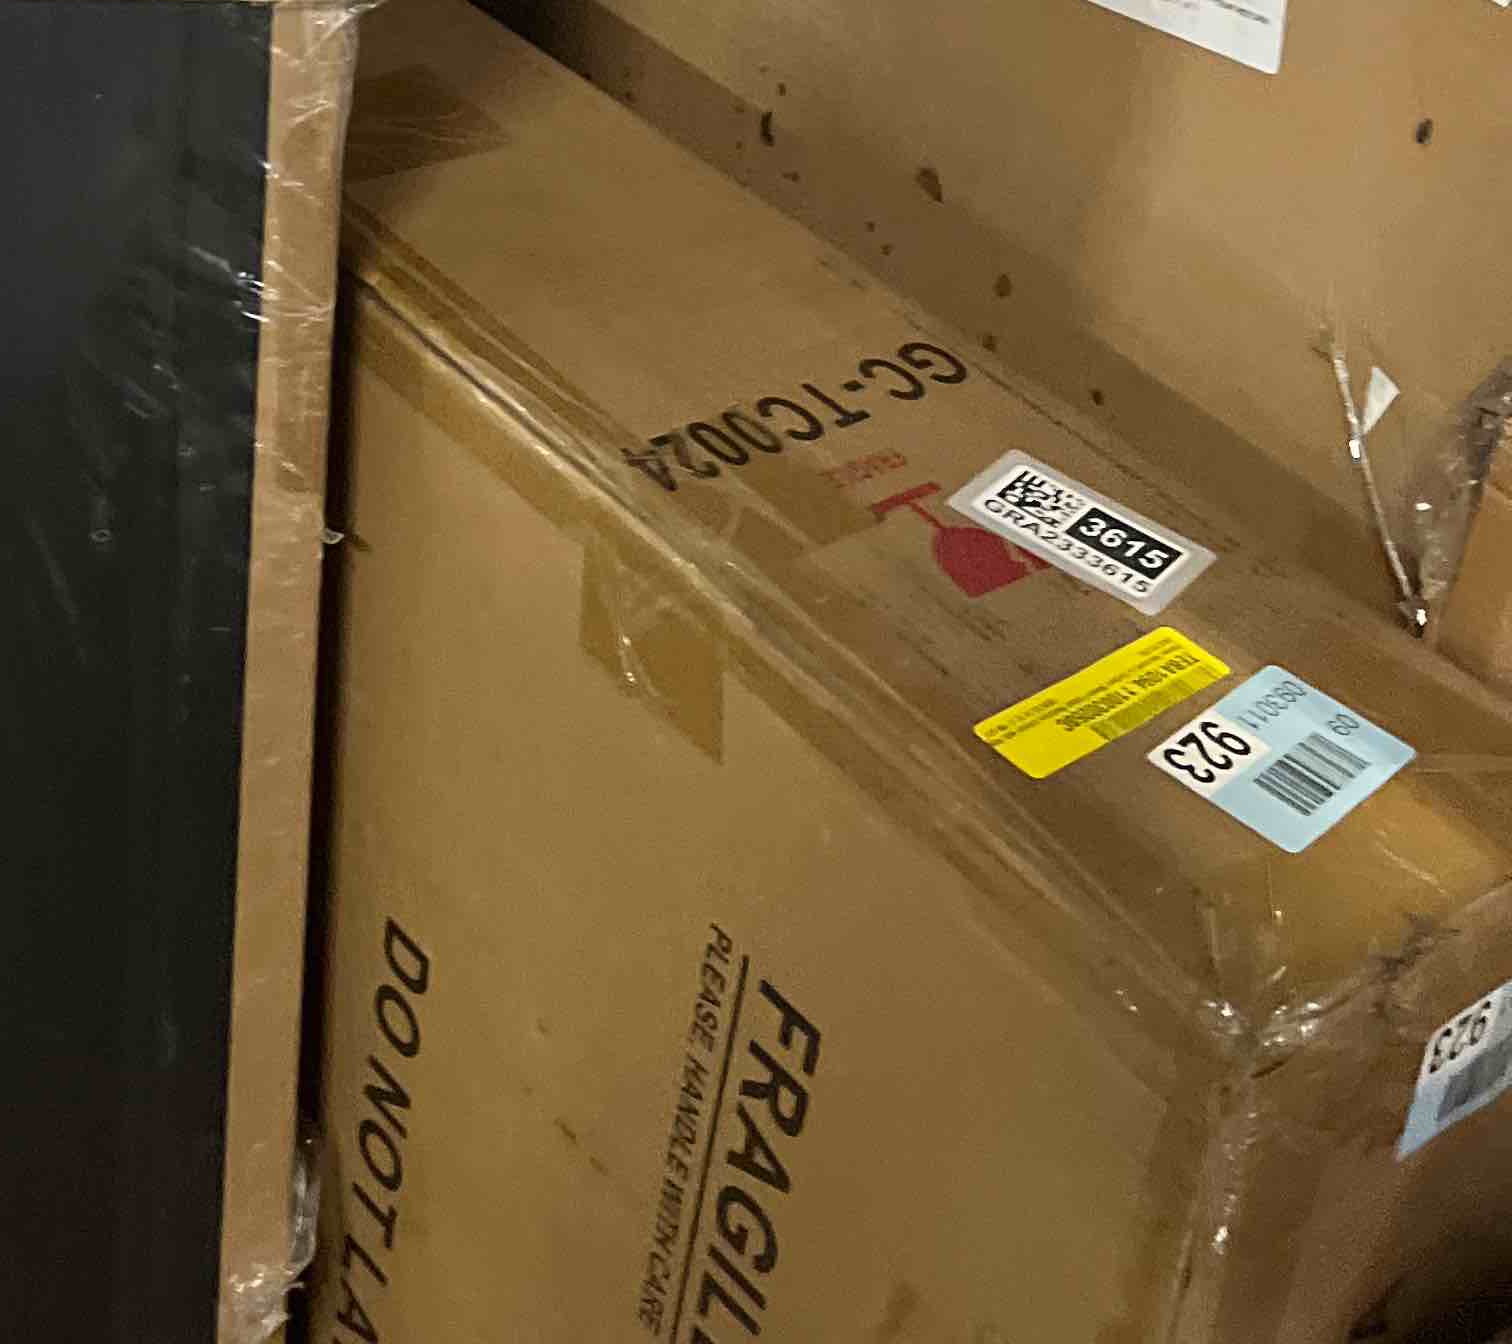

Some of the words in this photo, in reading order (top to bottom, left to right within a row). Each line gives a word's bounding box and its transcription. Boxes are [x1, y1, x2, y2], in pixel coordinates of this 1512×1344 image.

[621, 342, 967, 492] GC-TC0024
[984, 498, 1150, 594] GRA2333615
[1078, 516, 1169, 569] 3615
[1163, 720, 1251, 785] 923
[374, 916, 430, 1059] DO
[691, 923, 733, 1052] PLEASE
[690, 979, 822, 1344] FRAGIL
[333, 1233, 389, 1344] LA
